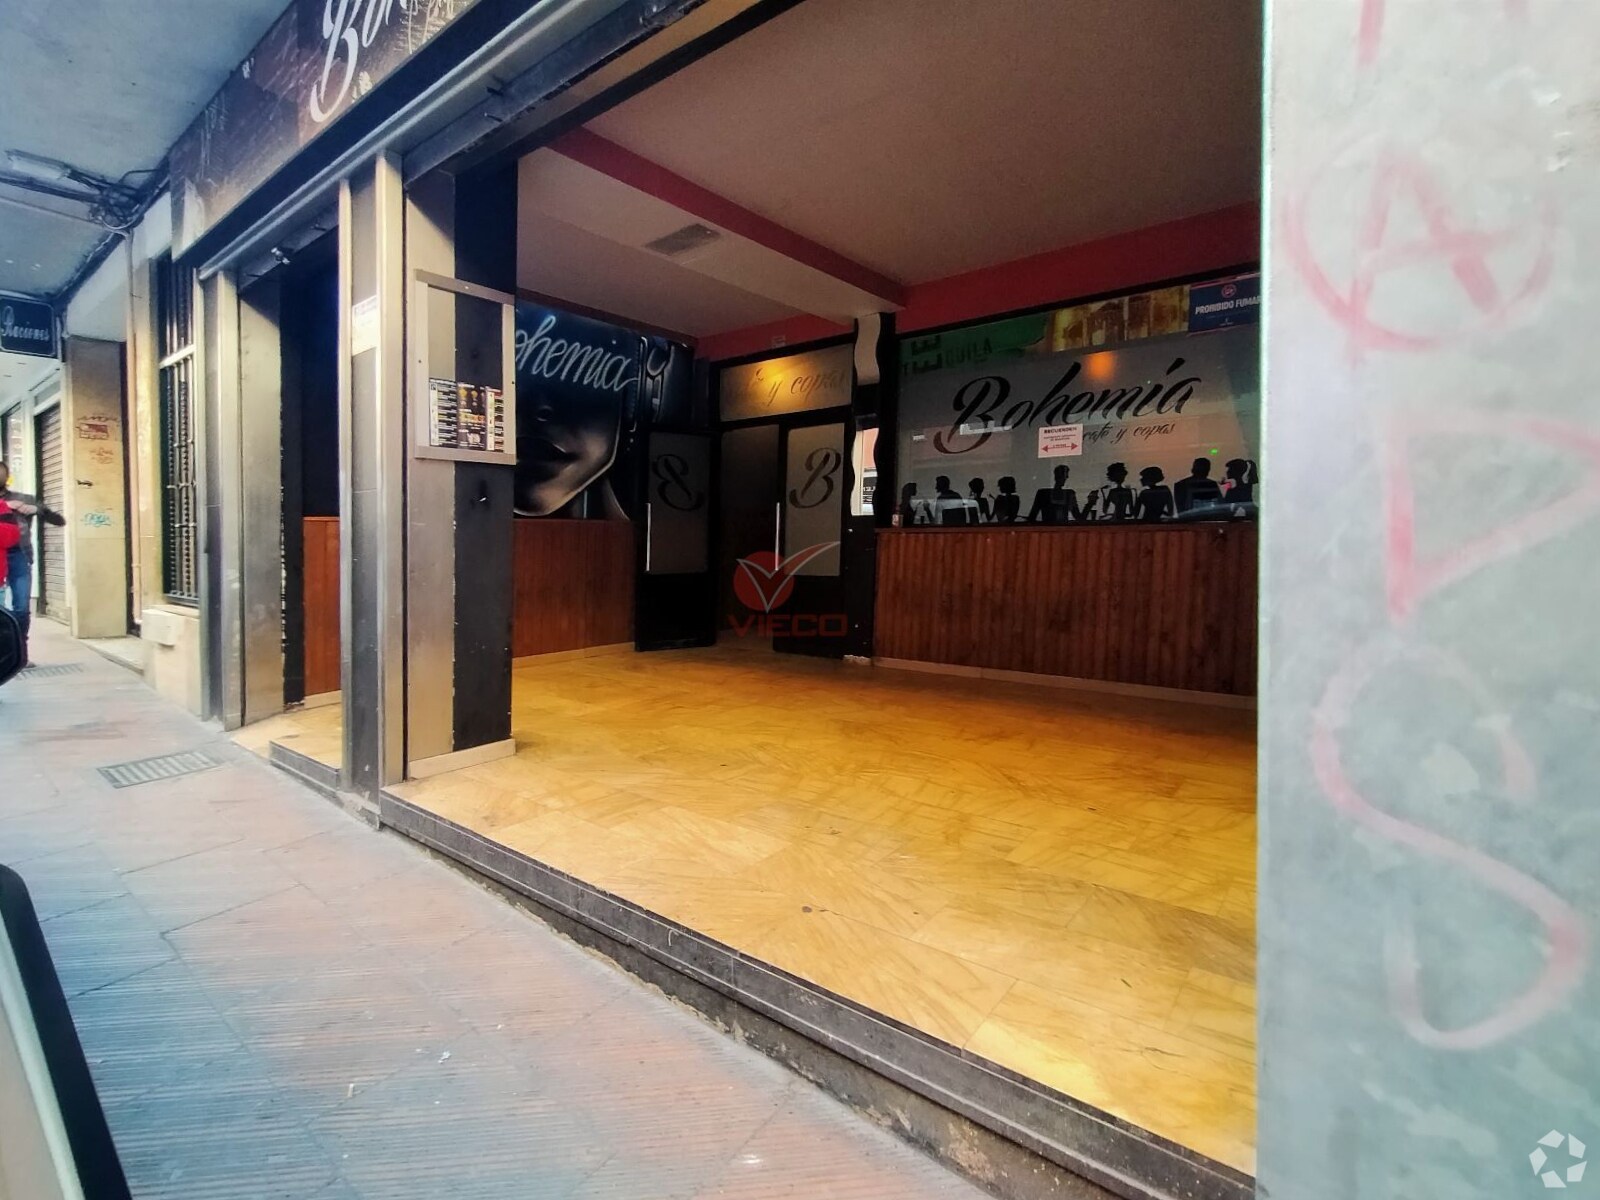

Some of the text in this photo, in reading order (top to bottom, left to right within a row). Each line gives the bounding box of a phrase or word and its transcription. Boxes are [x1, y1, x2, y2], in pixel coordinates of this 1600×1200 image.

[1194, 300, 1235, 315] PROHIBIDO
[1110, 428, 1128, 444] y
[1134, 423, 1176, 440] copas
[789, 447, 842, 509] B
